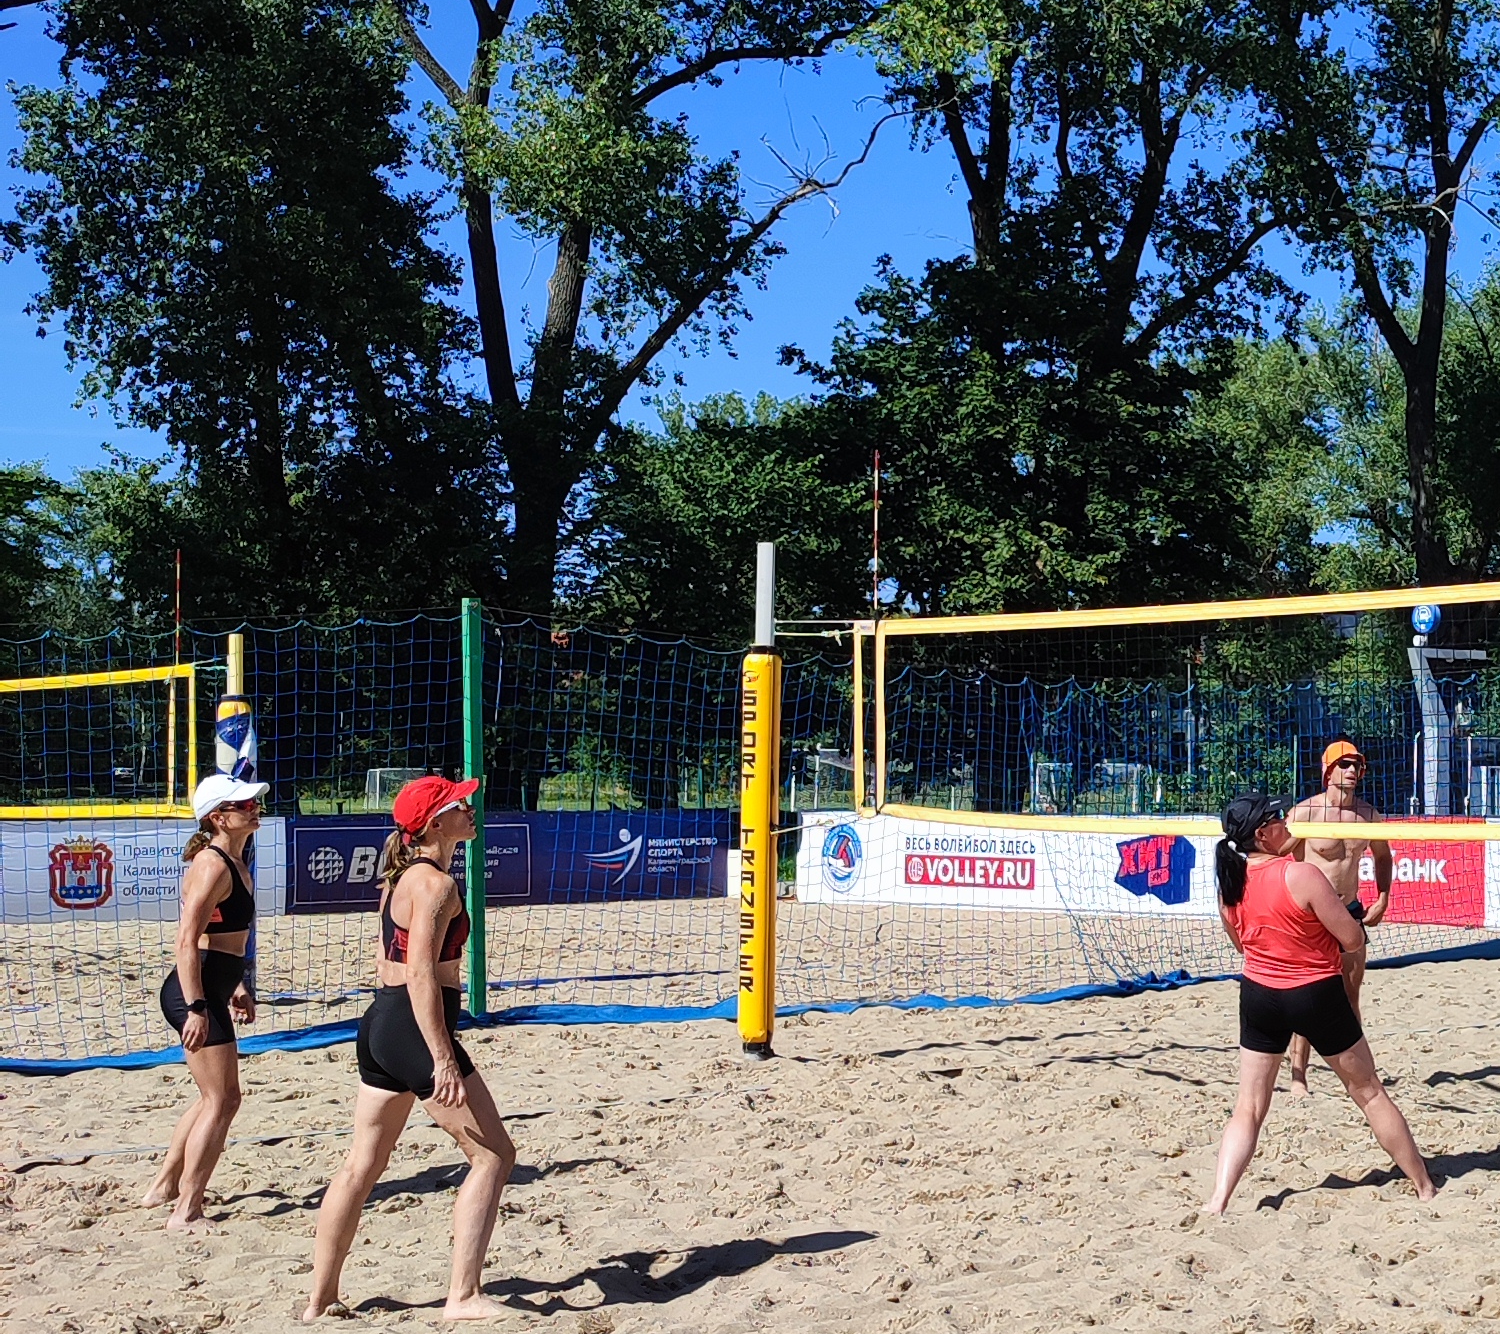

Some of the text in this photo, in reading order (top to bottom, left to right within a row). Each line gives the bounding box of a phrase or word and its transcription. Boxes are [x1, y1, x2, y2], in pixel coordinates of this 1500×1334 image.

[741, 690, 757, 791] SPORT
[647, 847, 684, 857] СПОРТА
[905, 836, 1036, 855] ВЕСЬ ВОЛЕЙБОЛ ЗДЕСЬ
[123, 864, 189, 877] Калининг
[926, 858, 1031, 887] VOLLEY.RU
[123, 883, 176, 897] области
[739, 828, 755, 993] TRANSFER
